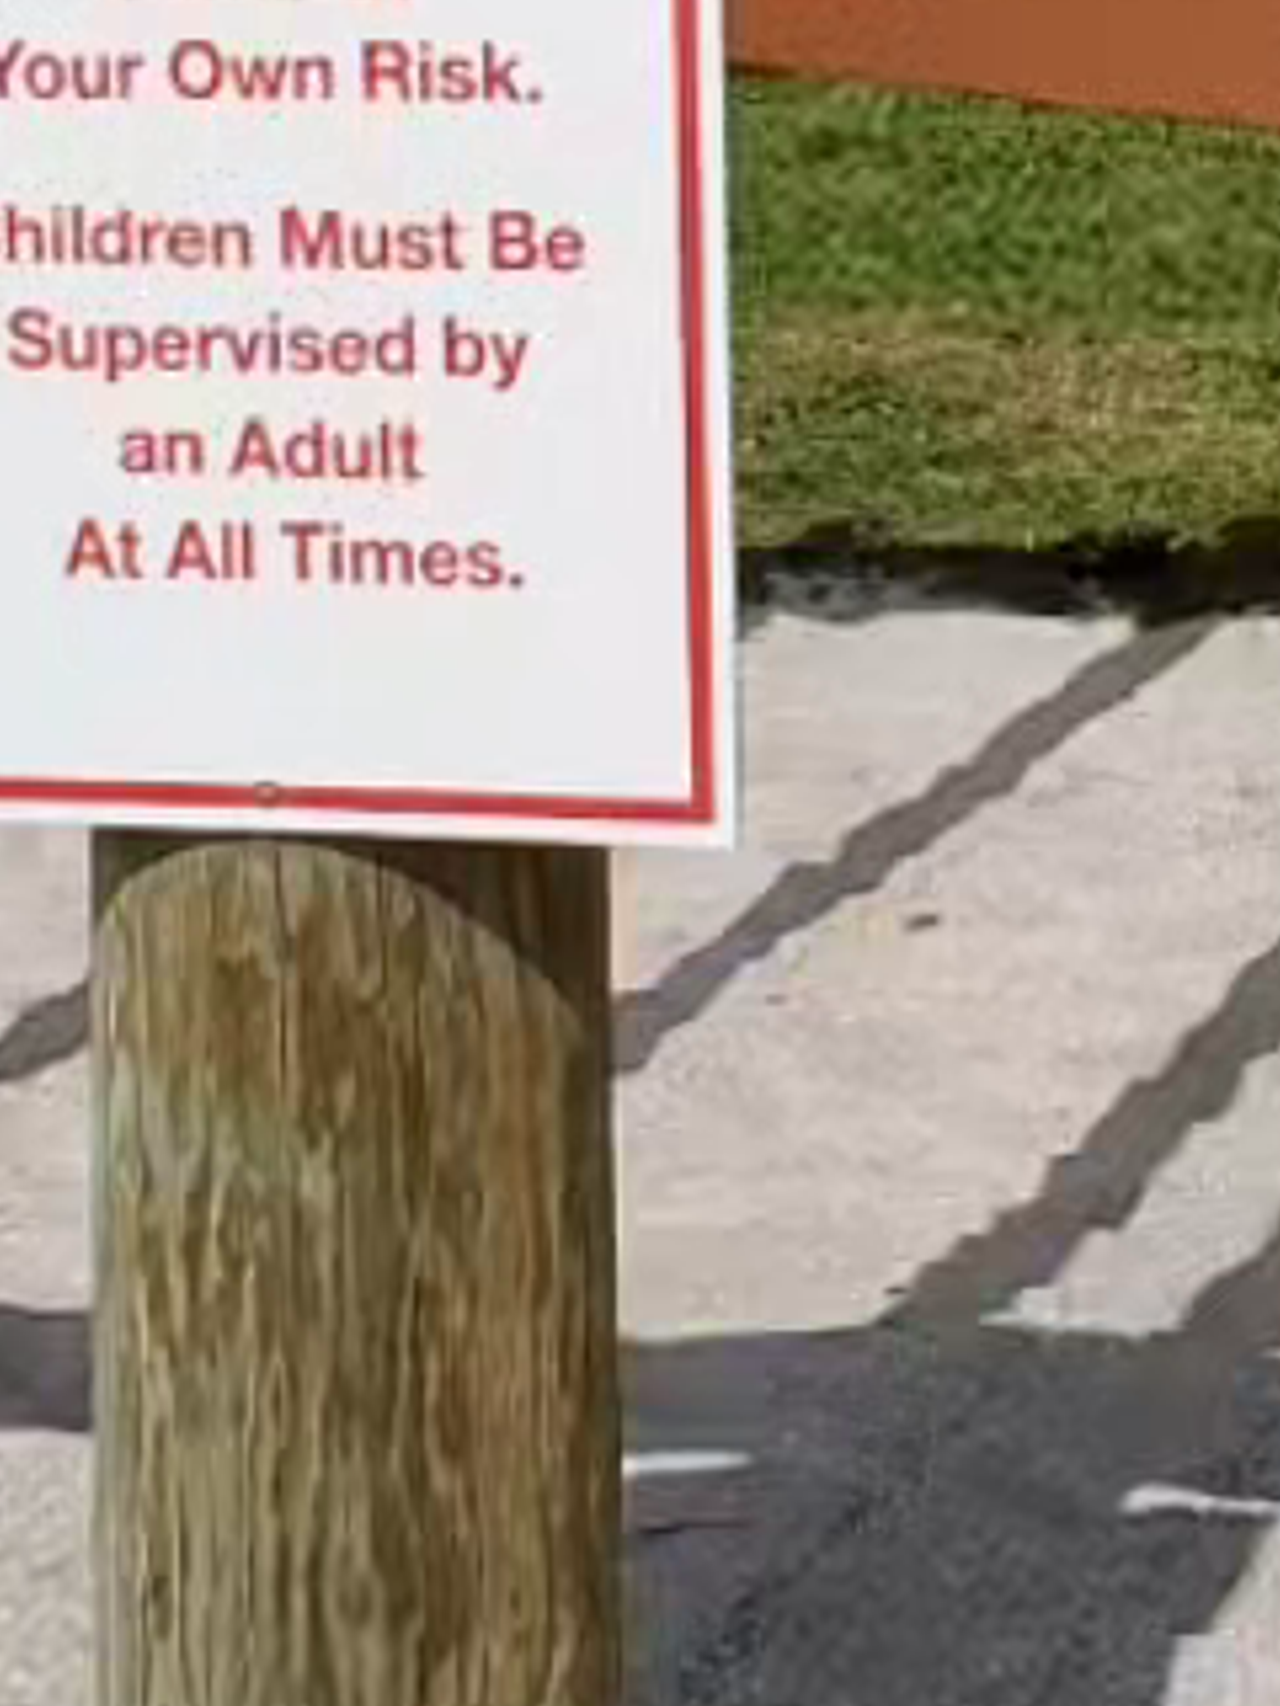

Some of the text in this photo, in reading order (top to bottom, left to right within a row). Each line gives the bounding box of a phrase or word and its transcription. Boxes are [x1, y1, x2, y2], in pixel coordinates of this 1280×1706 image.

[167, 39, 335, 101] Own
[361, 40, 542, 104] Risk.
[279, 205, 465, 271] Must
[489, 210, 586, 274] Be
[7, 307, 528, 392] Supervised by
[119, 416, 424, 483] an Adult
[64, 517, 524, 589] At All Times.
